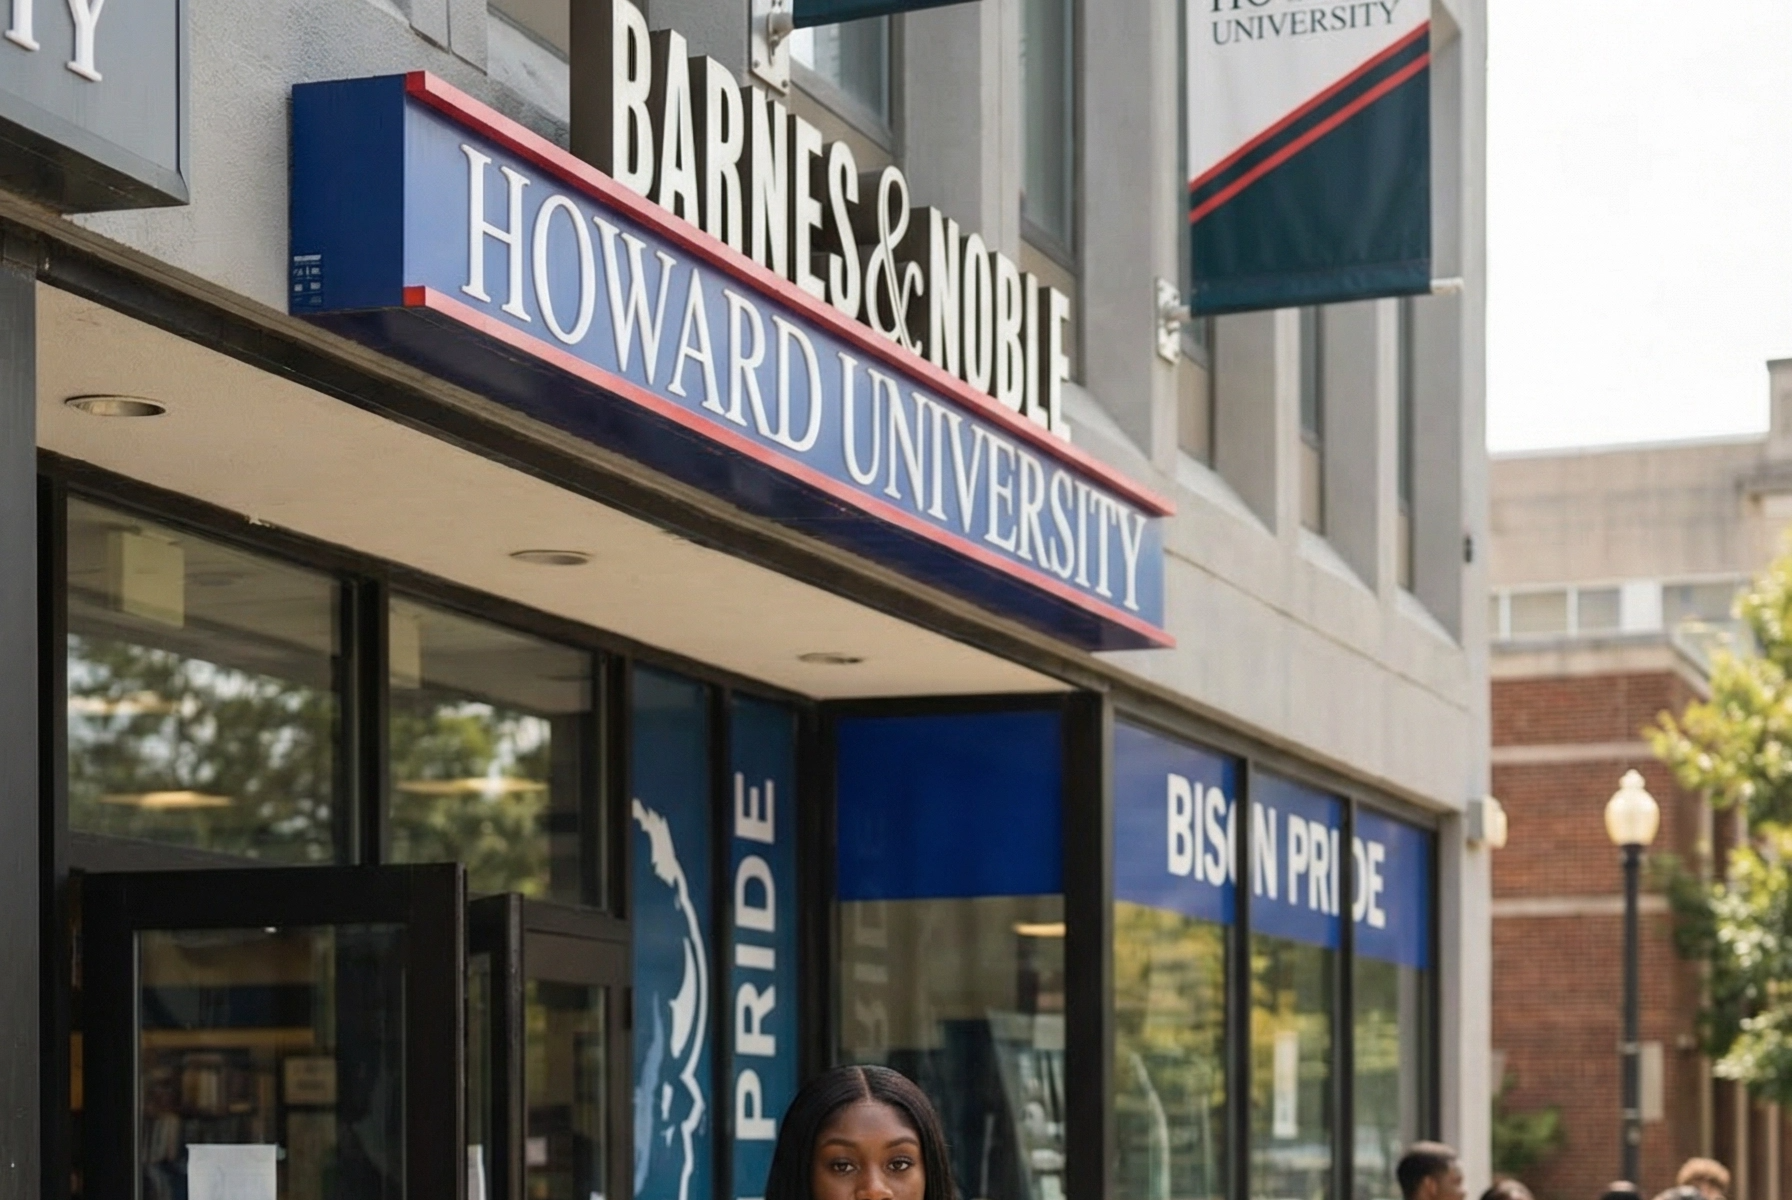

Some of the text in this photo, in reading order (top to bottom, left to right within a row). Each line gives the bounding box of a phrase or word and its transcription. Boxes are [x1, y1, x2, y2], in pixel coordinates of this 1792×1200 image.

[612, 0, 860, 321] BARNES
[930, 206, 1072, 443] NOBLE
[1211, 0, 1399, 45] UNIVERSITY
[460, 143, 1147, 611] HOWARD UNIVERSITY
[734, 772, 777, 1140] PRIDE
